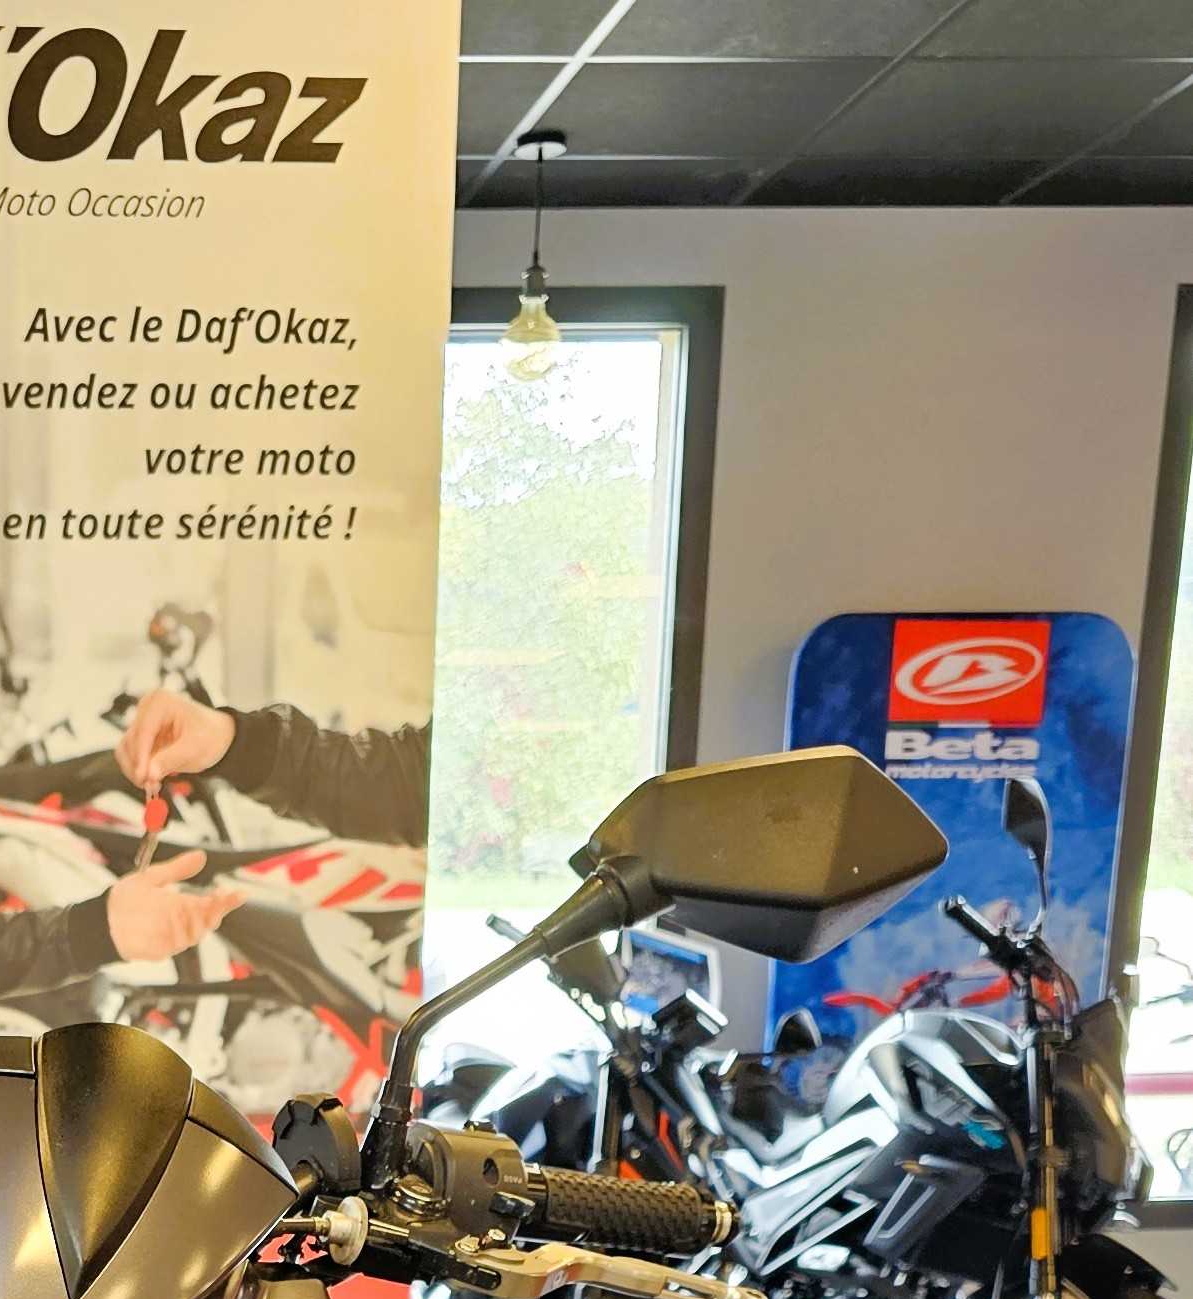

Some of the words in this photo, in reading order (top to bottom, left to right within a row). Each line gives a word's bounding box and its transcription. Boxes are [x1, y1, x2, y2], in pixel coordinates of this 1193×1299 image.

[68, 188, 205, 217] Occasion
[24, 308, 117, 342] Avec
[130, 306, 162, 342] le
[176, 307, 356, 354] Daf'Okaz,
[3, 373, 138, 409] vendez
[151, 383, 196, 409] ou
[211, 374, 359, 410] achetez
[146, 444, 244, 475] votre
[257, 445, 355, 475] moto
[3, 514, 46, 539] en
[62, 510, 163, 539] toute
[176, 504, 332, 539] sérénité
[884, 730, 1040, 760] Beta
